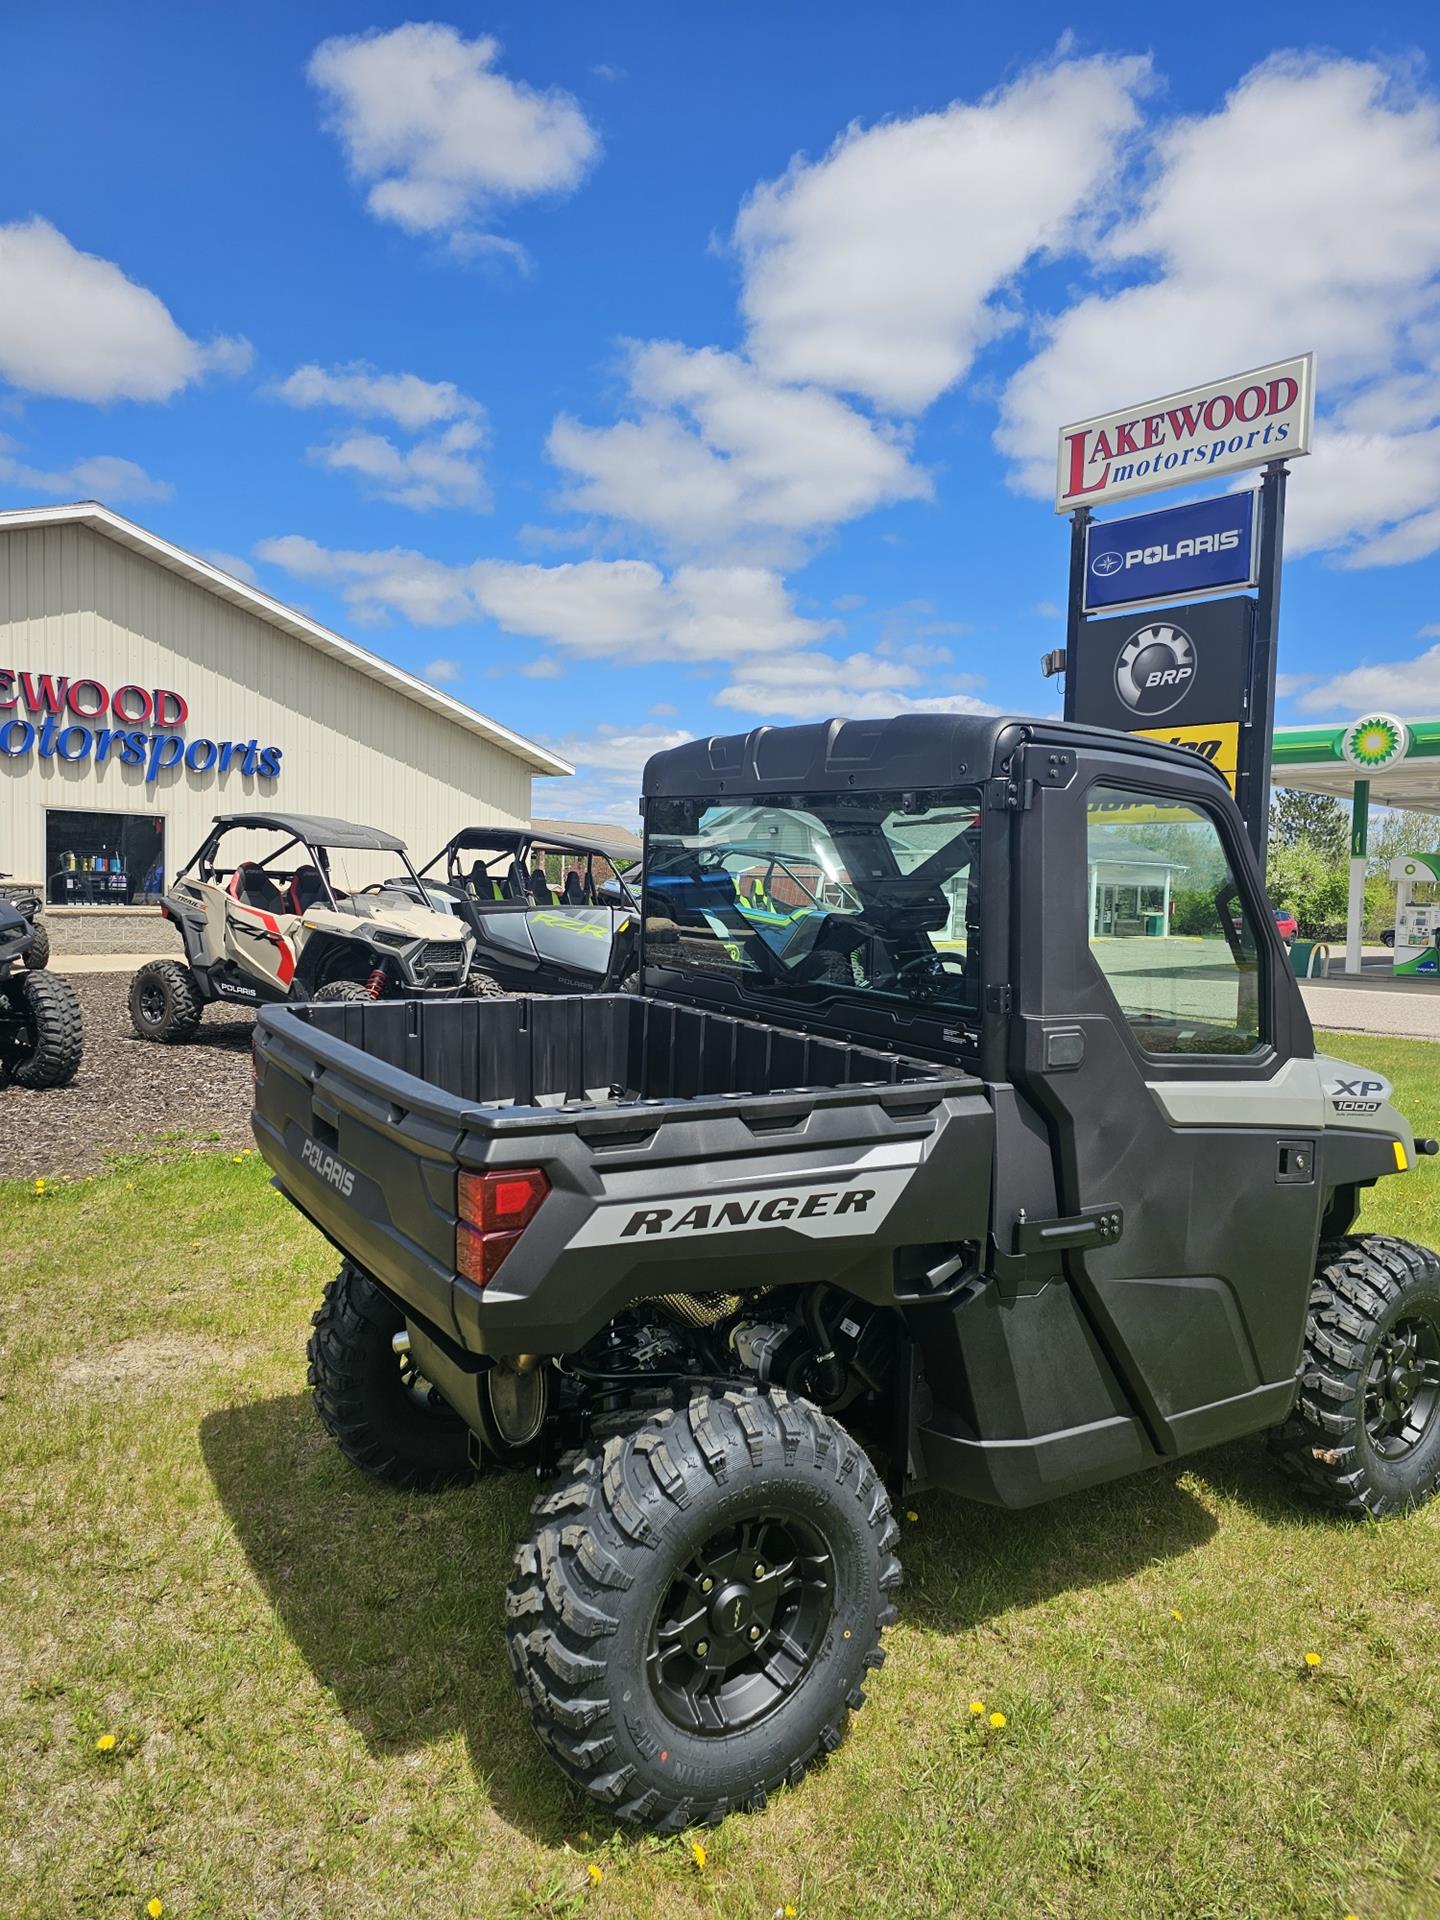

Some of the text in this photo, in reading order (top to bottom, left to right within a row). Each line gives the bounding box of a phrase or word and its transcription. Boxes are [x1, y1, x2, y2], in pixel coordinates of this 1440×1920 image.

[1062, 376, 1299, 499] LAKEWOOD
[1111, 421, 1291, 484] motorsports
[1125, 529, 1240, 569] POLARIS
[1145, 667, 1192, 688] BRP
[531, 912, 609, 939] RZR
[221, 983, 257, 997] POLARIS
[1331, 1079, 1384, 1097] XP
[1337, 1101, 1378, 1111] 1000
[301, 1138, 356, 1197] POLARIS
[619, 1189, 877, 1238] RANGER
